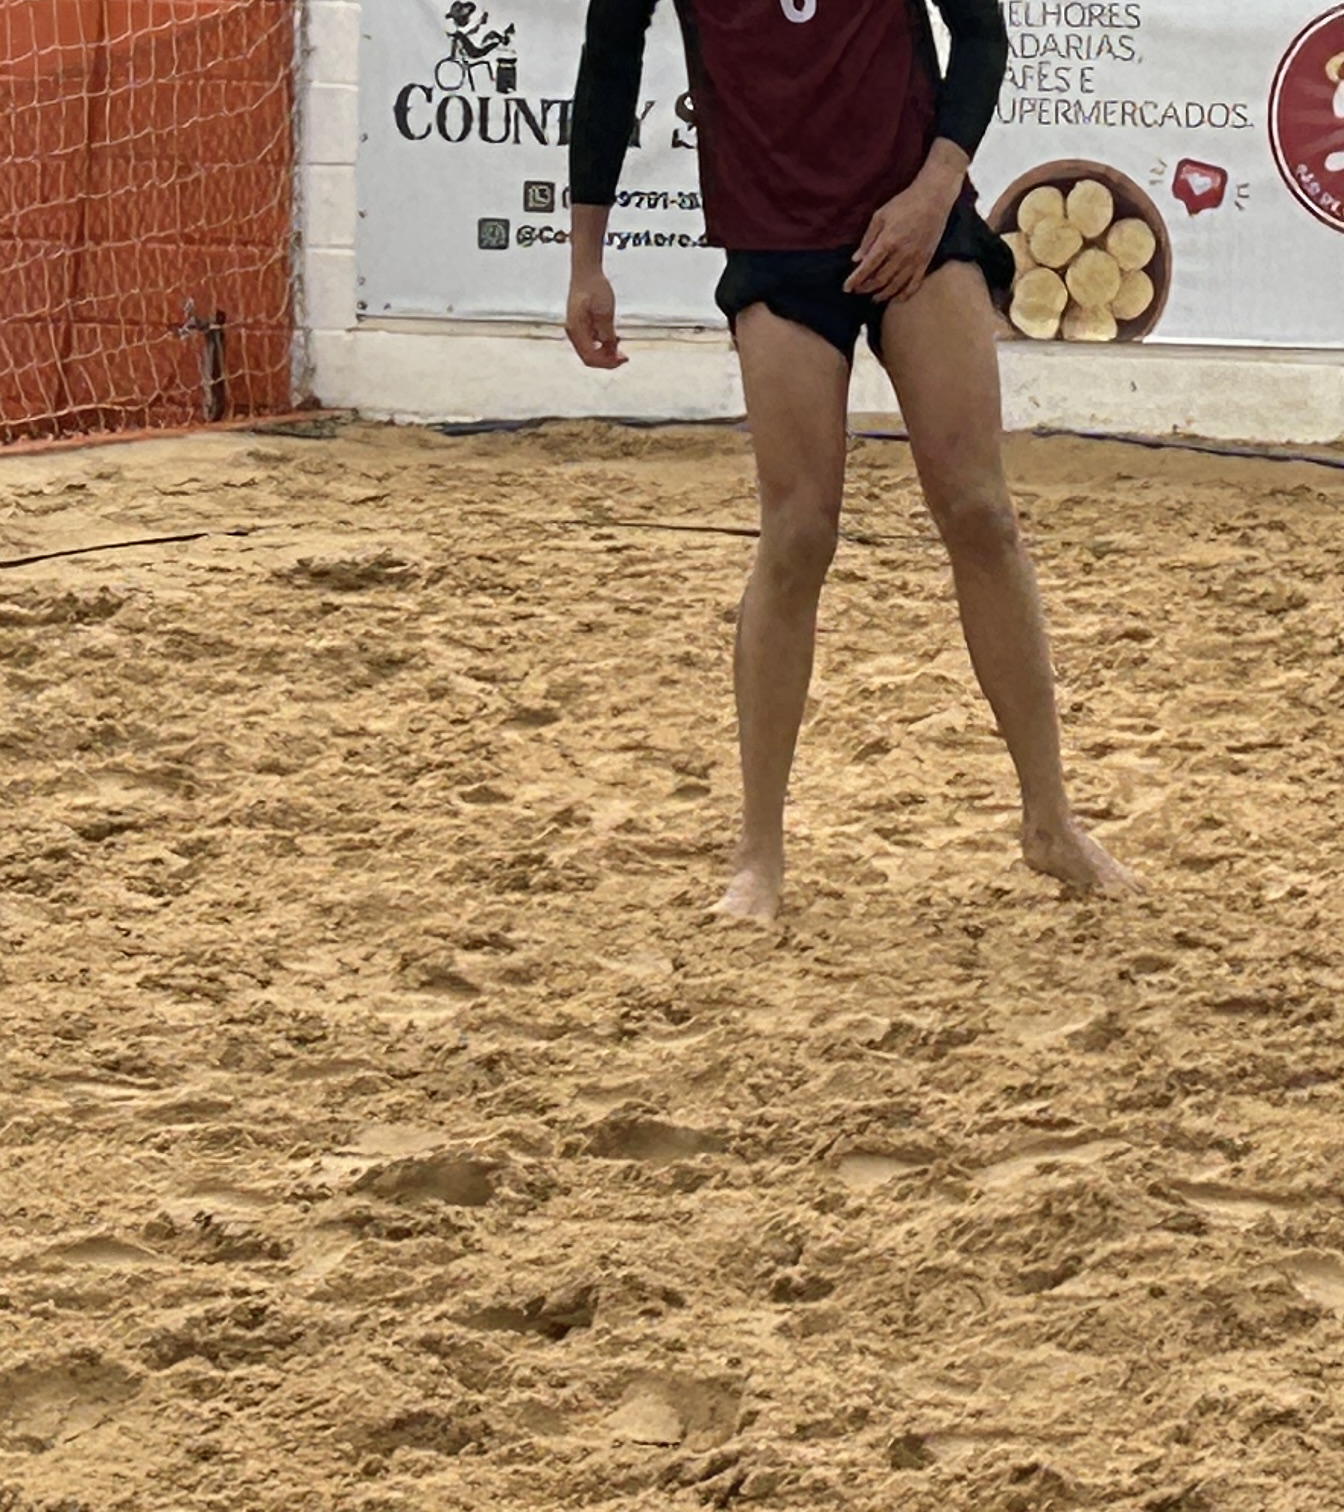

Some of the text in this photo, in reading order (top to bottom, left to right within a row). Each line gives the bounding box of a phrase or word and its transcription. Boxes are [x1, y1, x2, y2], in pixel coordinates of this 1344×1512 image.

[998, 0, 1141, 29] ELHORES
[1006, 33, 1144, 65] DARIAS,
[1080, 66, 1094, 93] E
[393, 83, 655, 148] COUNTY
[997, 97, 1254, 129] UPERMERCADOS.
